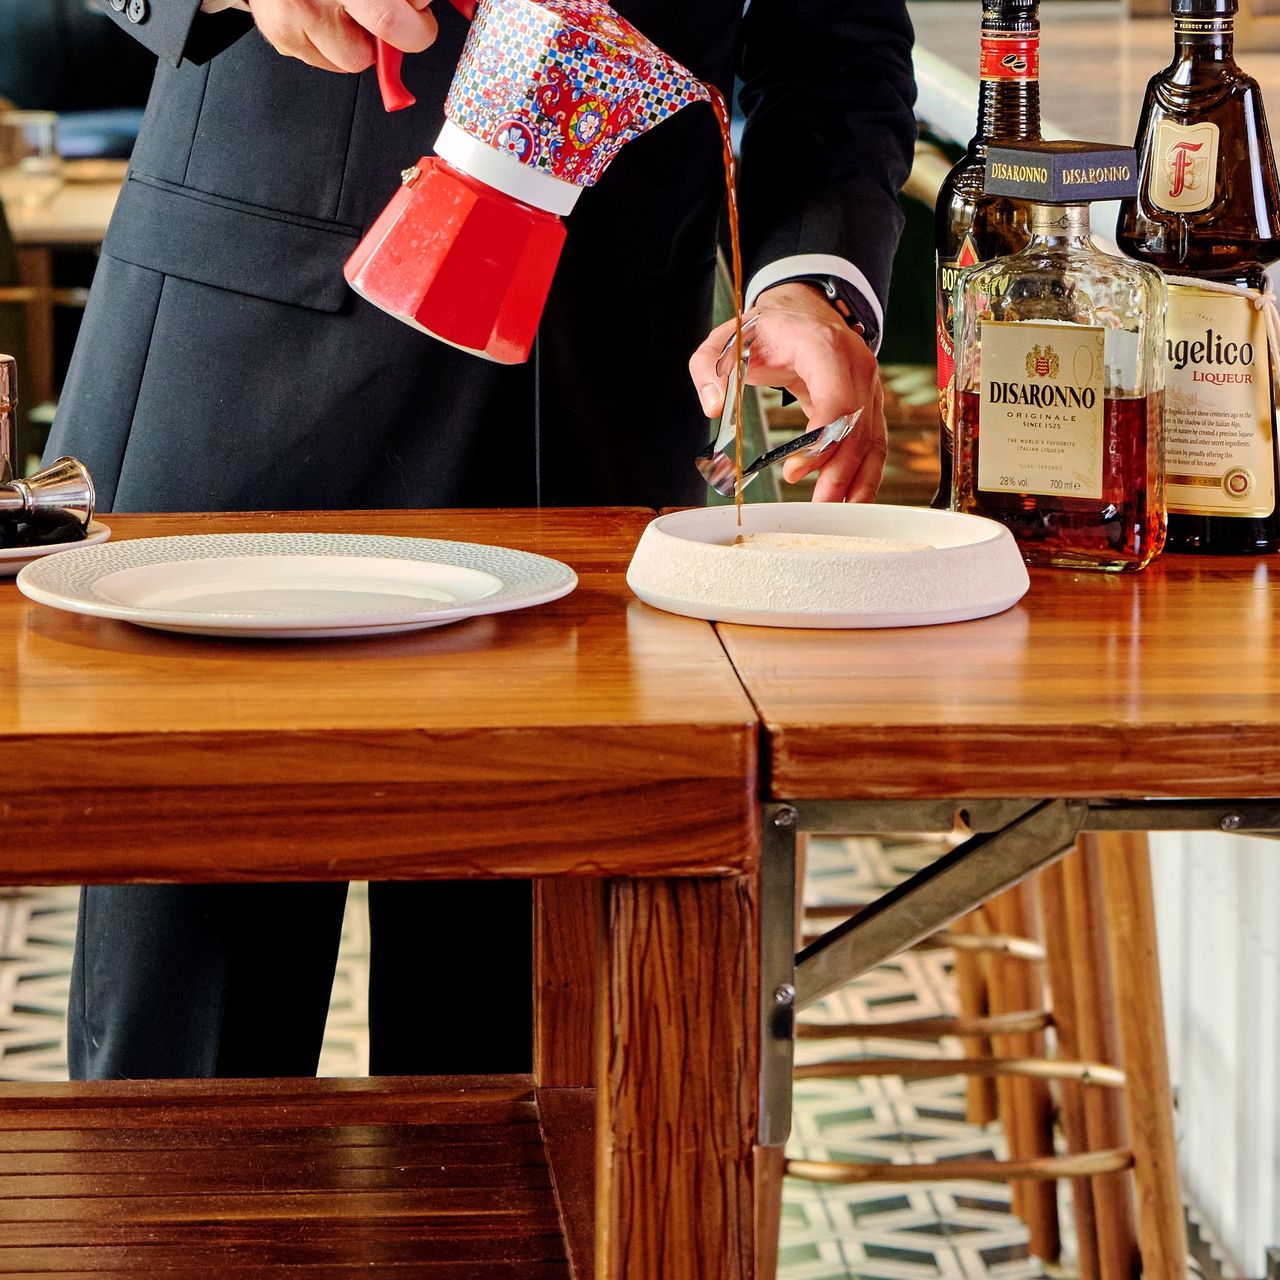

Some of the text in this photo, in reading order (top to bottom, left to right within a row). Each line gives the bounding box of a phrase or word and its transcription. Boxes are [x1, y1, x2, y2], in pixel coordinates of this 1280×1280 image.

[991, 162, 1048, 184] DISARONNO
[1062, 165, 1131, 185] DISARONNO
[941, 334, 952, 356] VERO
[1192, 370, 1253, 386] LIQUEUR
[989, 381, 1095, 409] DISARONNO
[1007, 411, 1077, 422] ORIGINALE
[1197, 409, 1209, 417] three
[1210, 410, 1230, 418] centuries
[1188, 449, 1205, 459] proudly
[1000, 476, 1016, 486] 28%
[1050, 479, 1062, 489] 700
[1064, 481, 1072, 490] ml
